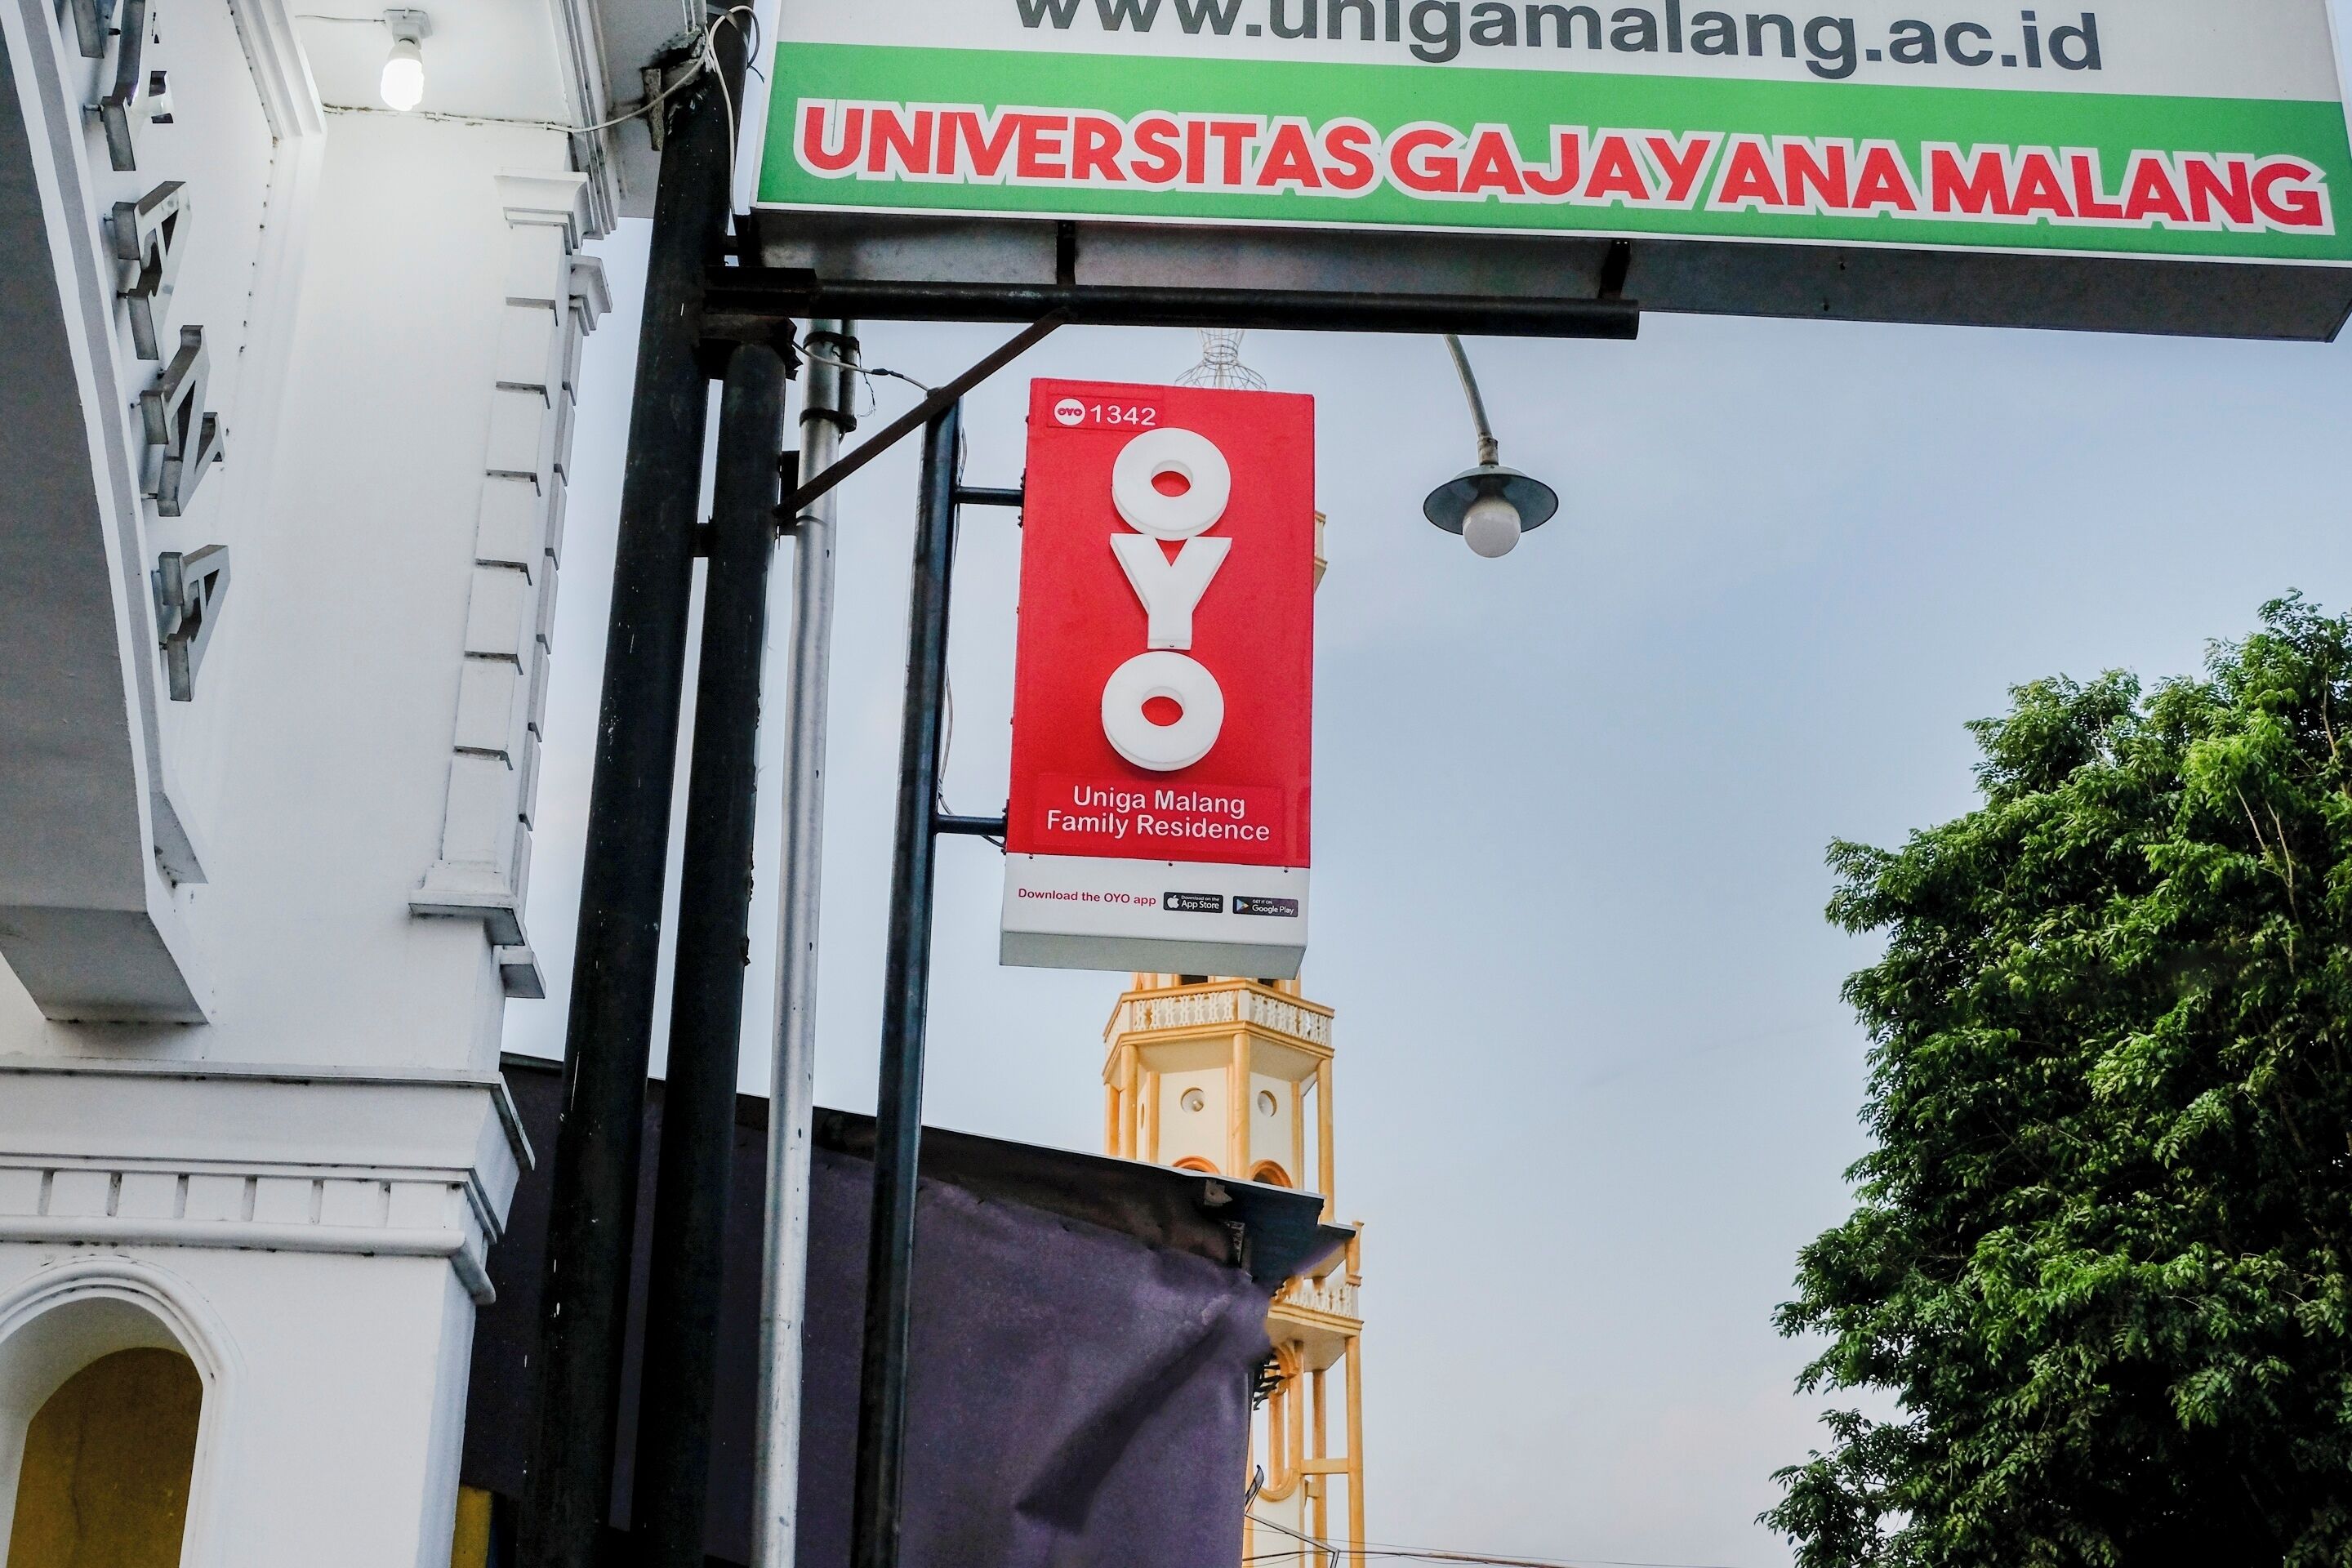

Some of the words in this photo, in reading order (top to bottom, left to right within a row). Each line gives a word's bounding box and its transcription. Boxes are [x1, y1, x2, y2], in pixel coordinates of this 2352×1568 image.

[801, 105, 1375, 191] UNIVERSITAS
[1388, 128, 1918, 212] GAJAYANA
[1931, 149, 2325, 228] MALANG
[1057, 408, 1083, 416] OYO
[1089, 404, 1156, 425] 1342
[1101, 427, 1233, 772] OYO
[1073, 785, 1147, 813] Uniga
[1154, 789, 1245, 820] Malang
[1046, 809, 1129, 840] Family
[1137, 814, 1271, 842] Residence
[1018, 888, 1078, 901] Download
[1081, 891, 1101, 902] the
[1103, 893, 1131, 904] OYO
[1133, 895, 1157, 906] app
[1181, 900, 1198, 909] App
[1199, 901, 1220, 910] Store
[1252, 904, 1279, 914] Google
[1279, 905, 1294, 915] Play
